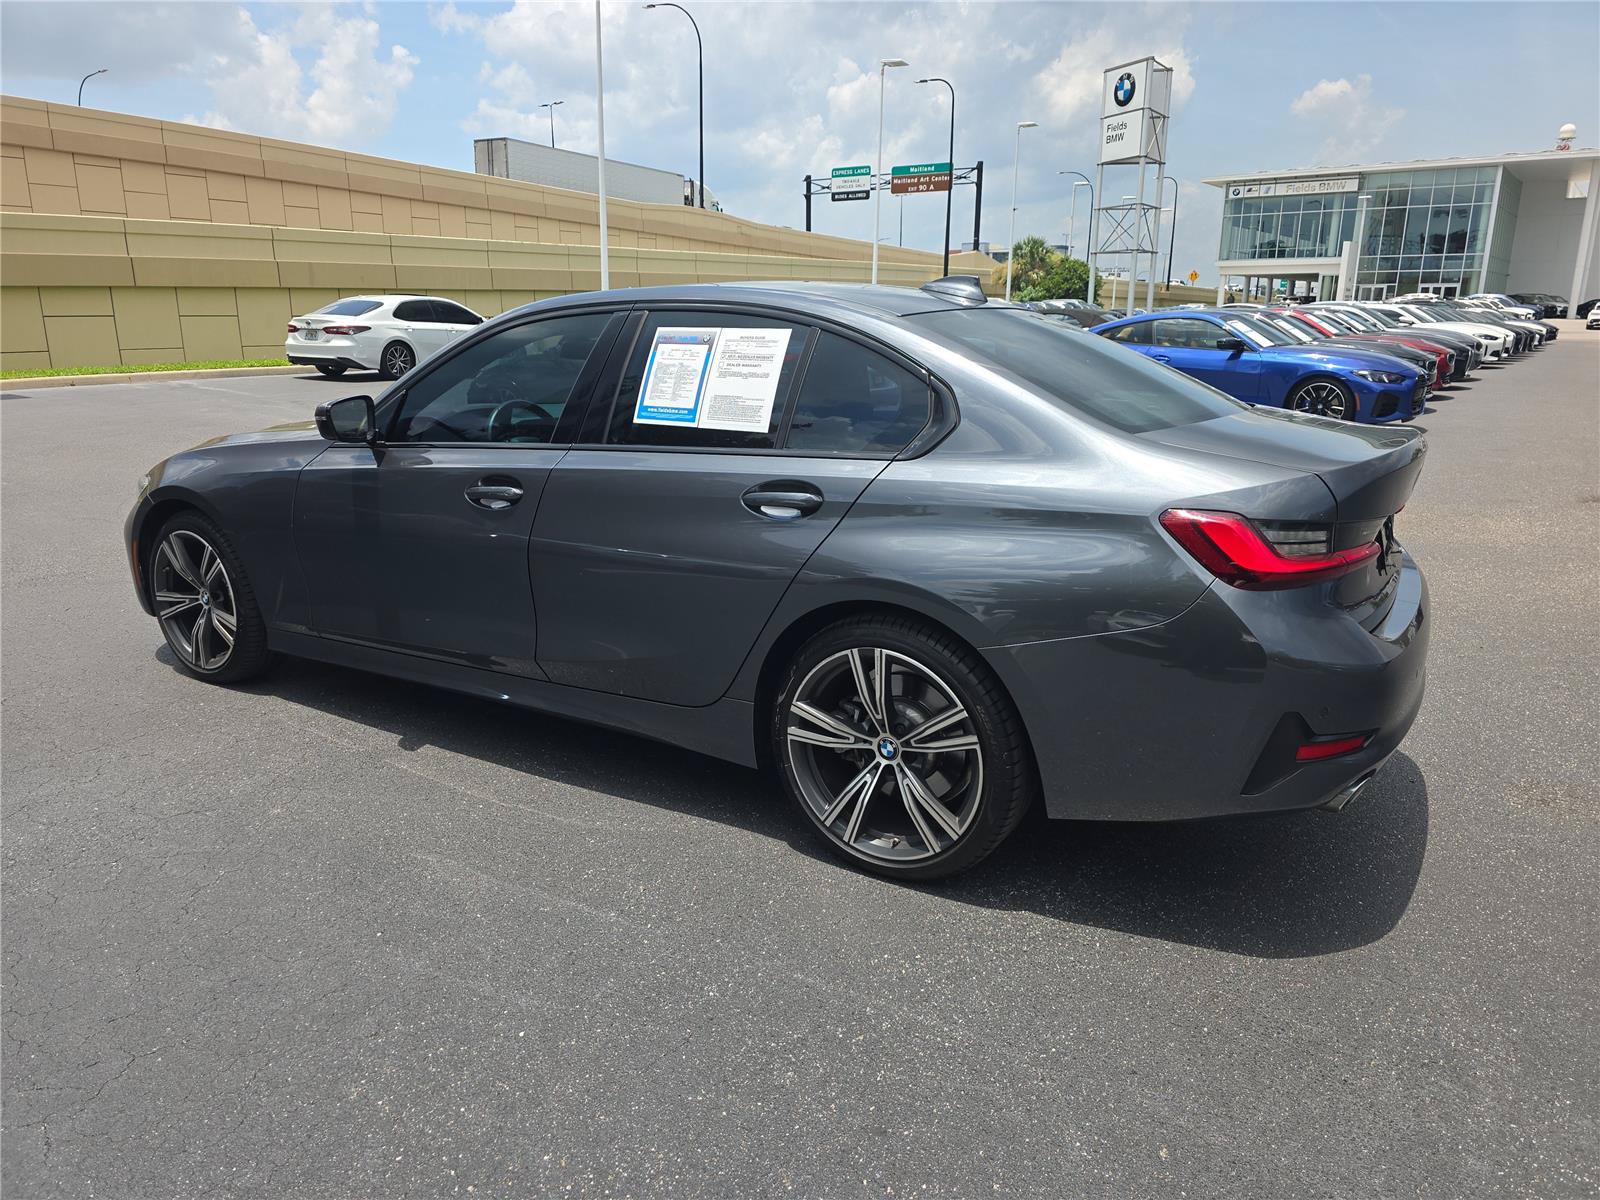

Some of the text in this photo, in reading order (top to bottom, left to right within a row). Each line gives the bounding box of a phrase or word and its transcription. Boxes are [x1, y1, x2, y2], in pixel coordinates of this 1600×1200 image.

[1106, 121, 1128, 133] Fields
[1105, 132, 1125, 144] BMW
[909, 165, 935, 173] Maitland
[1285, 181, 1348, 193] Fields BMW
